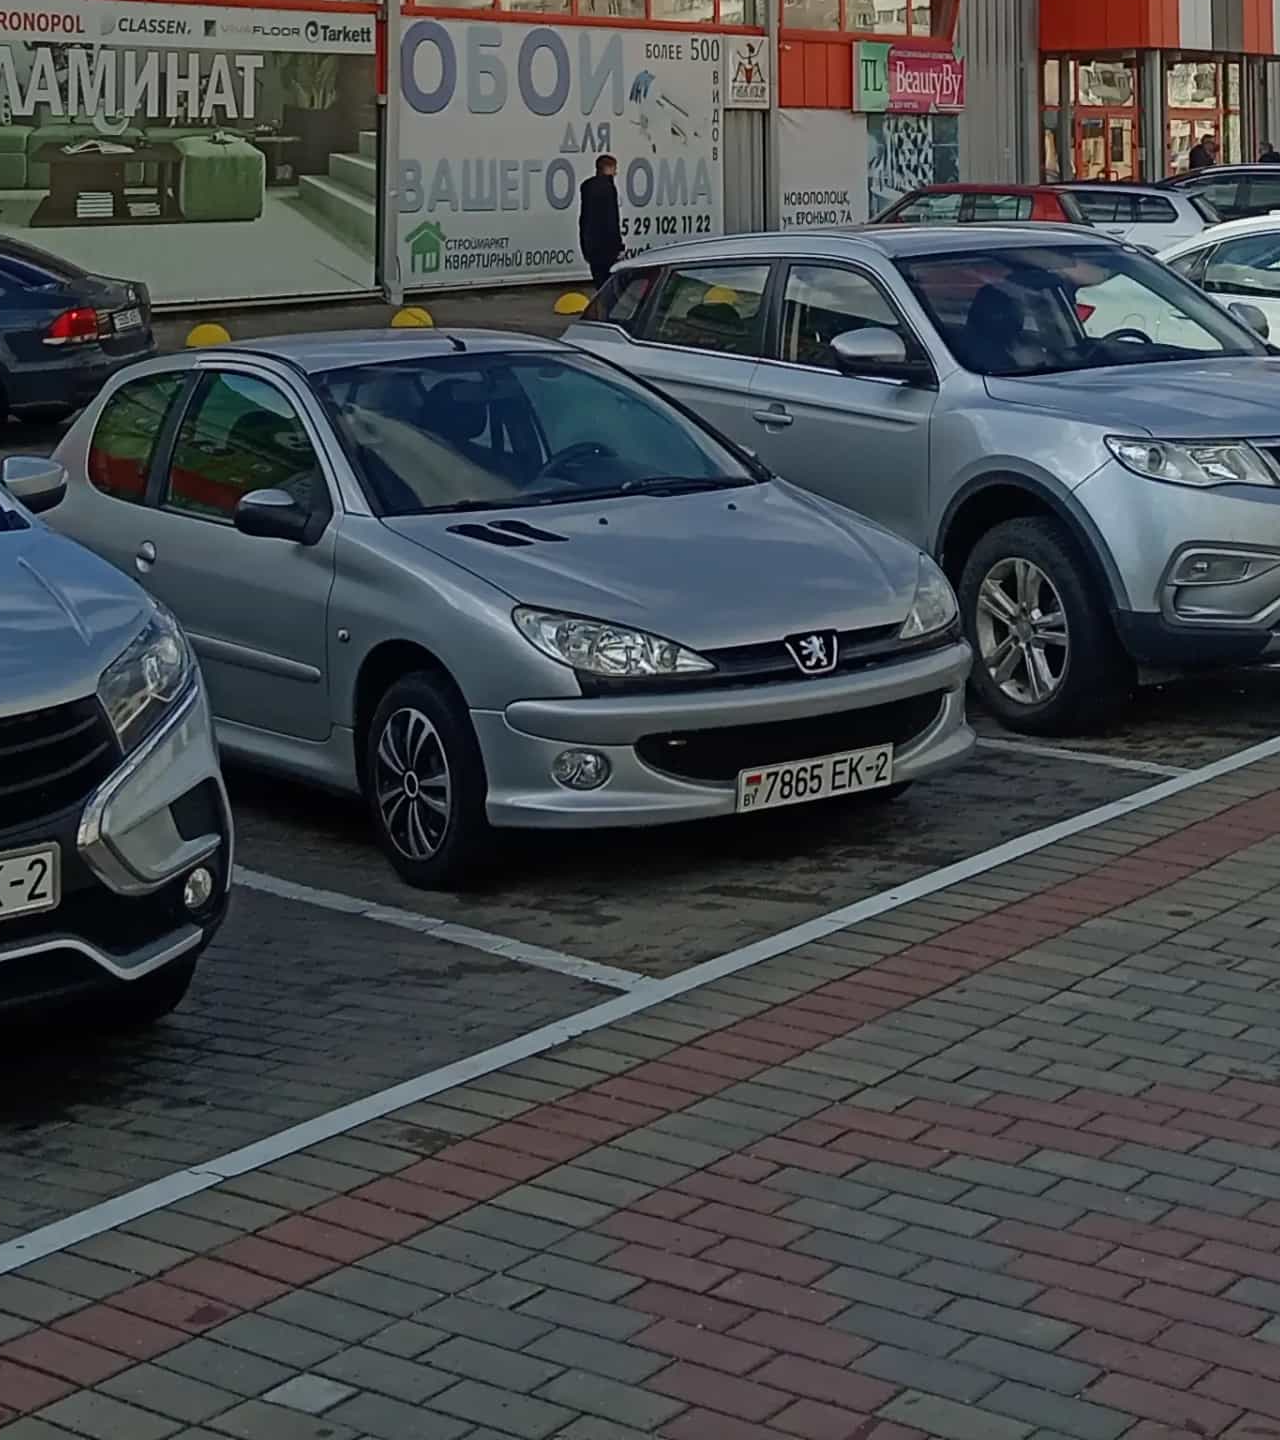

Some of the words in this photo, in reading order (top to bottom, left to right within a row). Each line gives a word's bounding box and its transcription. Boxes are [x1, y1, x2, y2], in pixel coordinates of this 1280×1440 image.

[321, 24, 371, 43] Tarkett
[645, 43, 683, 61] БОЛЕЕ
[689, 38, 720, 62] 500
[400, 20, 624, 116] ОБОИ
[896, 61, 962, 105] BeautyBy
[559, 122, 611, 153] ДЛЯ
[399, 158, 576, 213] ВАШЕГО
[618, 157, 713, 209] ОМА
[784, 190, 850, 207] НОВОПОЛОЦК,
[634, 217, 651, 236] 29
[655, 216, 677, 234] 102
[682, 215, 692, 233] 11
[696, 215, 711, 232] 22
[796, 211, 839, 226] ЕРОНЬКО,
[840, 210, 852, 223] 7А
[445, 237, 510, 251] СТРОЙМАРКЕТ
[445, 250, 521, 270] КВАРТИРНЫЙ
[526, 250, 575, 266] ВОПРОС
[743, 789, 758, 807] BY
[764, 764, 824, 803] 7865
[831, 752, 888, 791] EK-2
